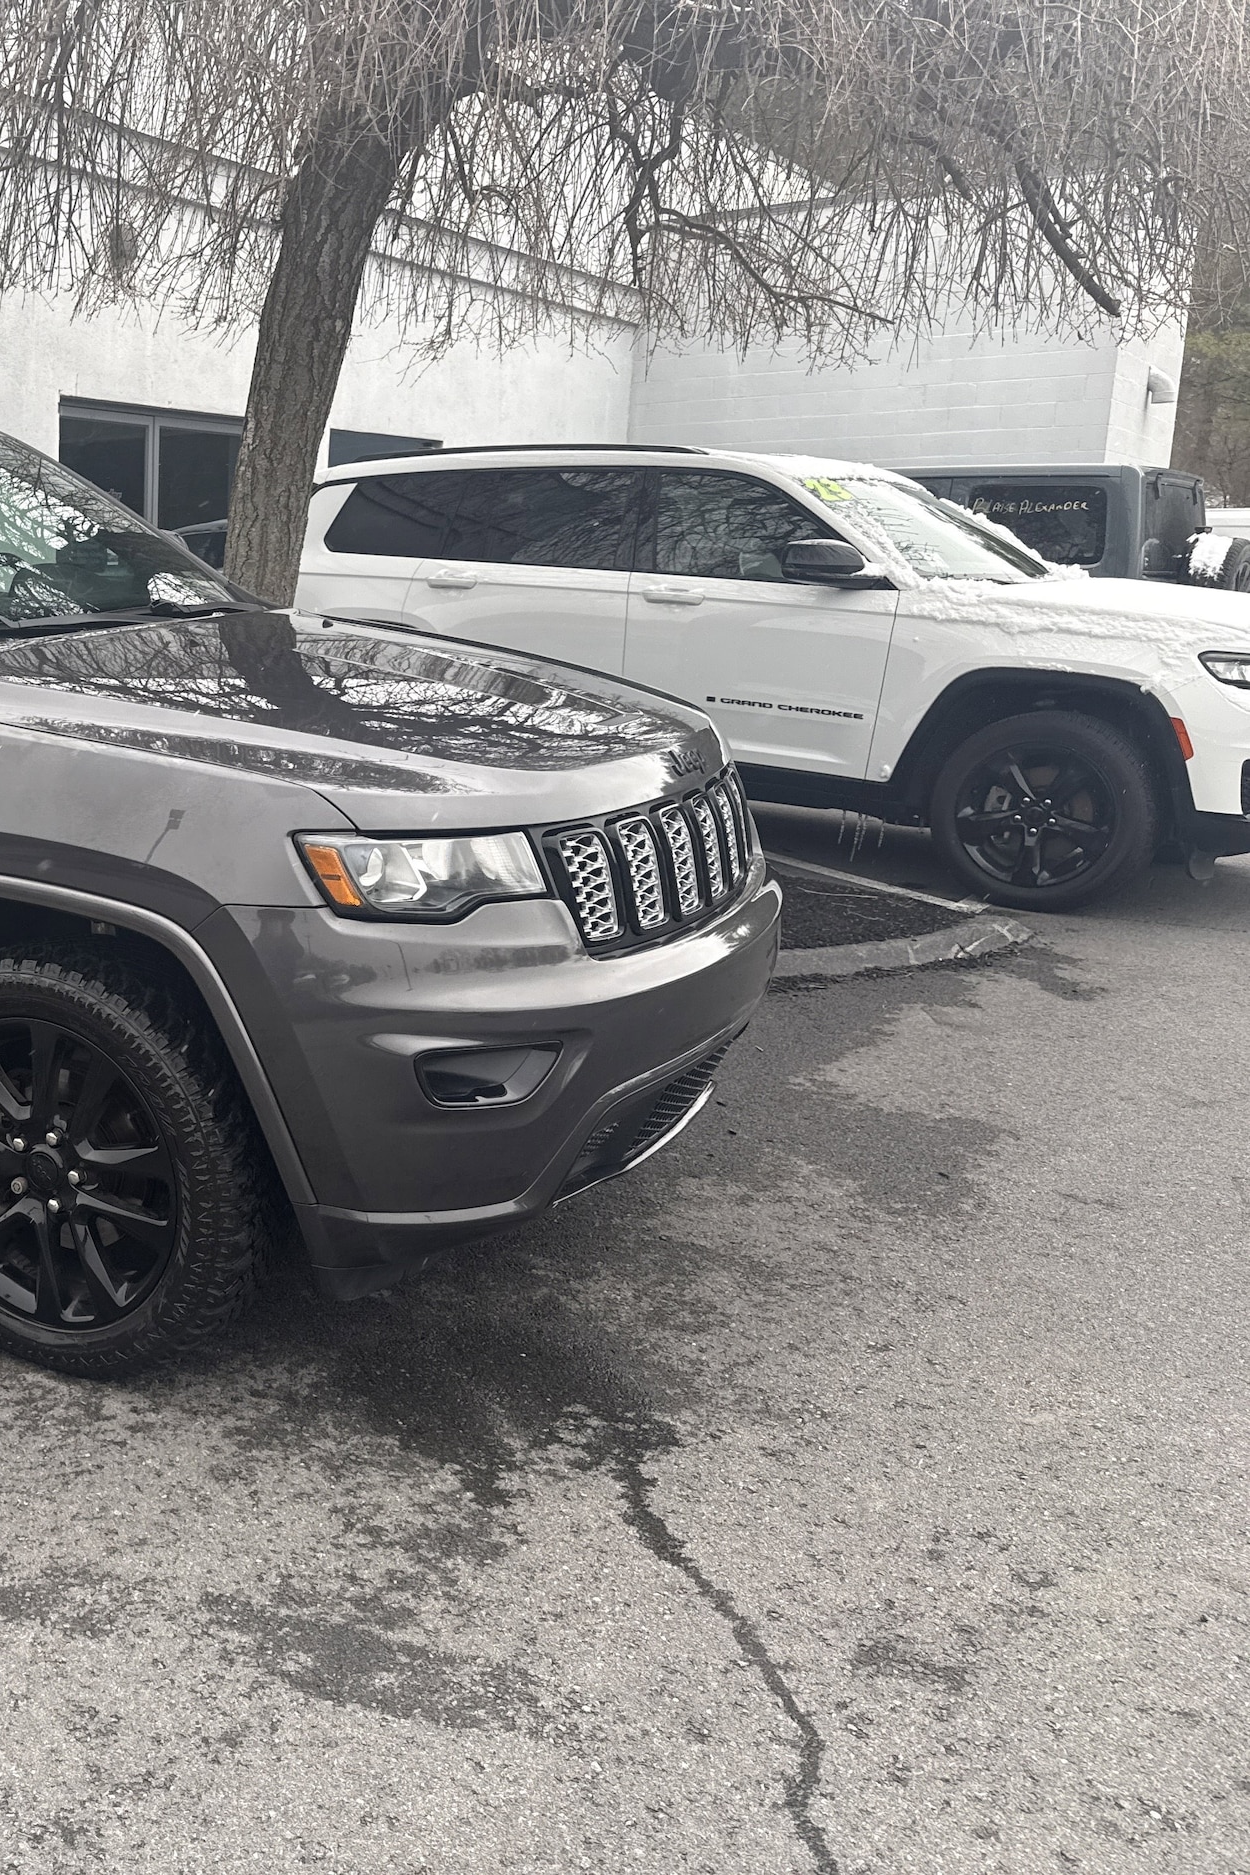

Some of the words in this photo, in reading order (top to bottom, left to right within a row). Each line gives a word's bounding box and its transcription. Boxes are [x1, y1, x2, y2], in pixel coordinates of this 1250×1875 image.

[720, 697, 773, 709] GRAND
[777, 704, 864, 720] CHEROKEE
[667, 749, 705, 777] Jeep
